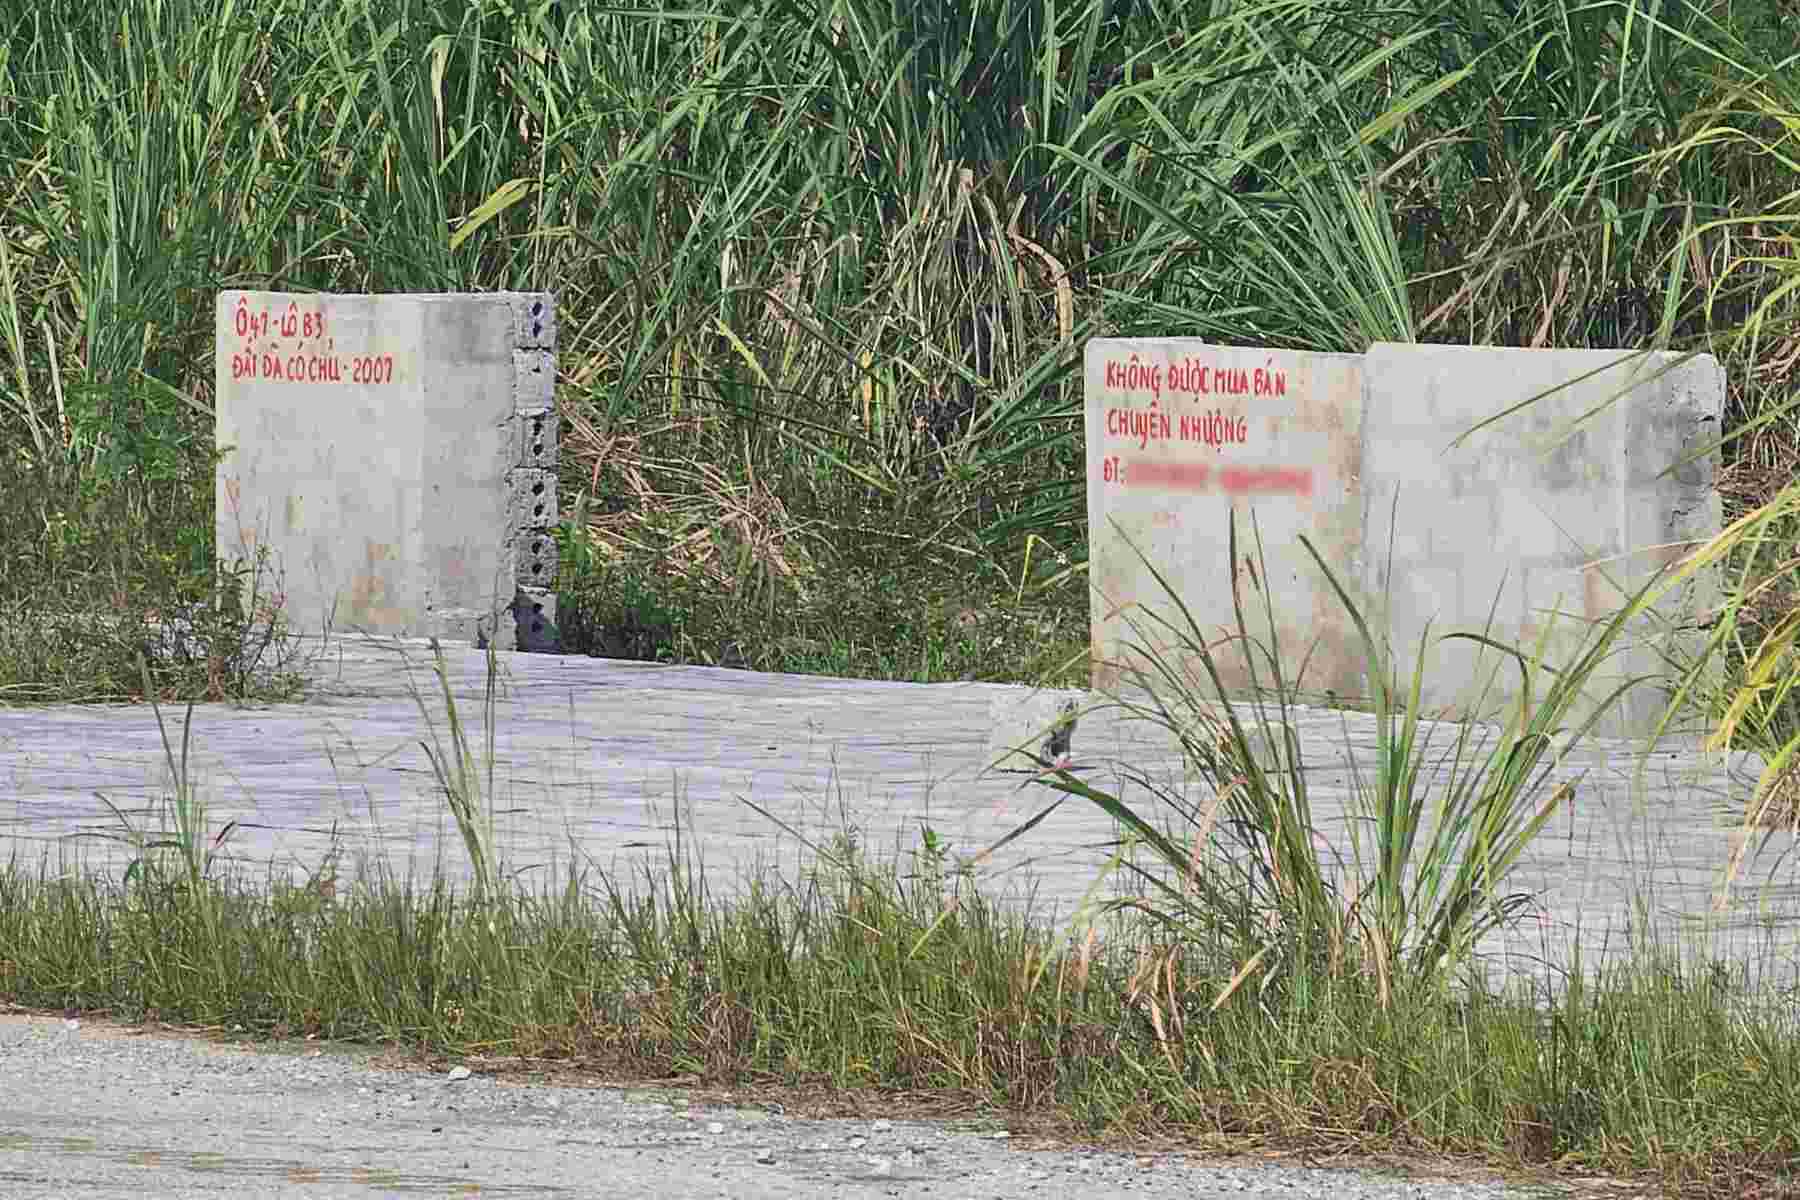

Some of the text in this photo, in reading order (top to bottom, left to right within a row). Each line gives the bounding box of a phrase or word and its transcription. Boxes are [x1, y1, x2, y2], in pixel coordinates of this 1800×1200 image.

[352, 355, 393, 385] 2007
[1106, 354, 1162, 399] KHÔNG
[1253, 357, 1287, 397] BÁN
